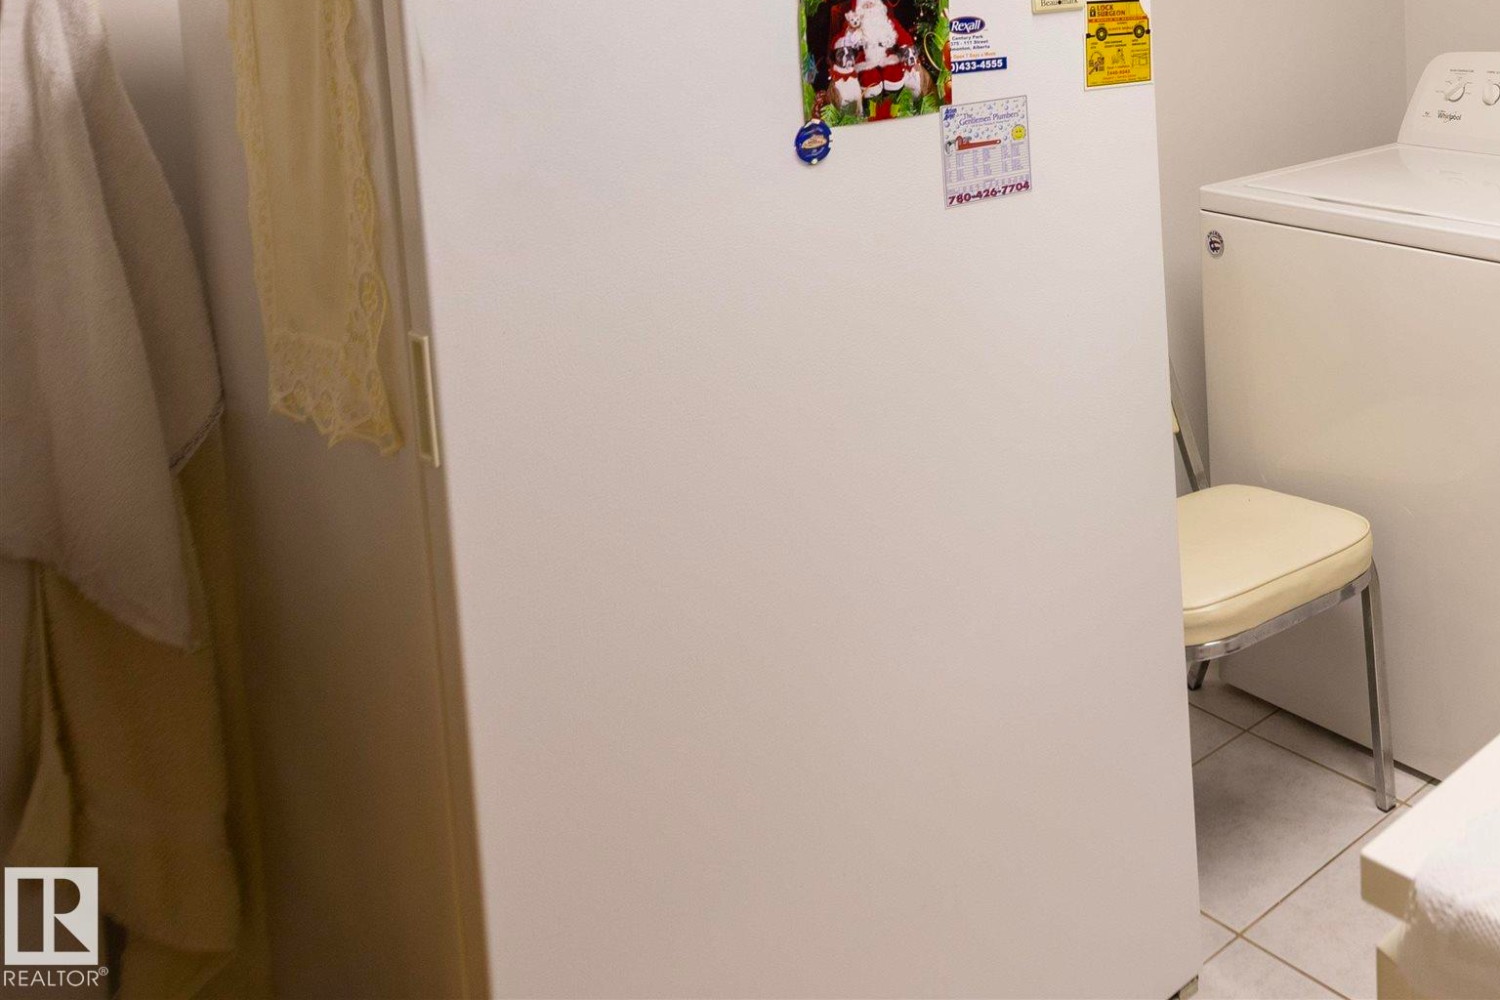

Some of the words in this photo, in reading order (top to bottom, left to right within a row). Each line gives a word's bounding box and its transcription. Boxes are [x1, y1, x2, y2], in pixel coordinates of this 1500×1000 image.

[951, 19, 981, 33] Rexall
[959, 115, 992, 126] Gentlemen
[992, 111, 1019, 121] Plumbers
[1438, 112, 1462, 121] Whirlpool
[948, 181, 1030, 205] 780-426-7704
